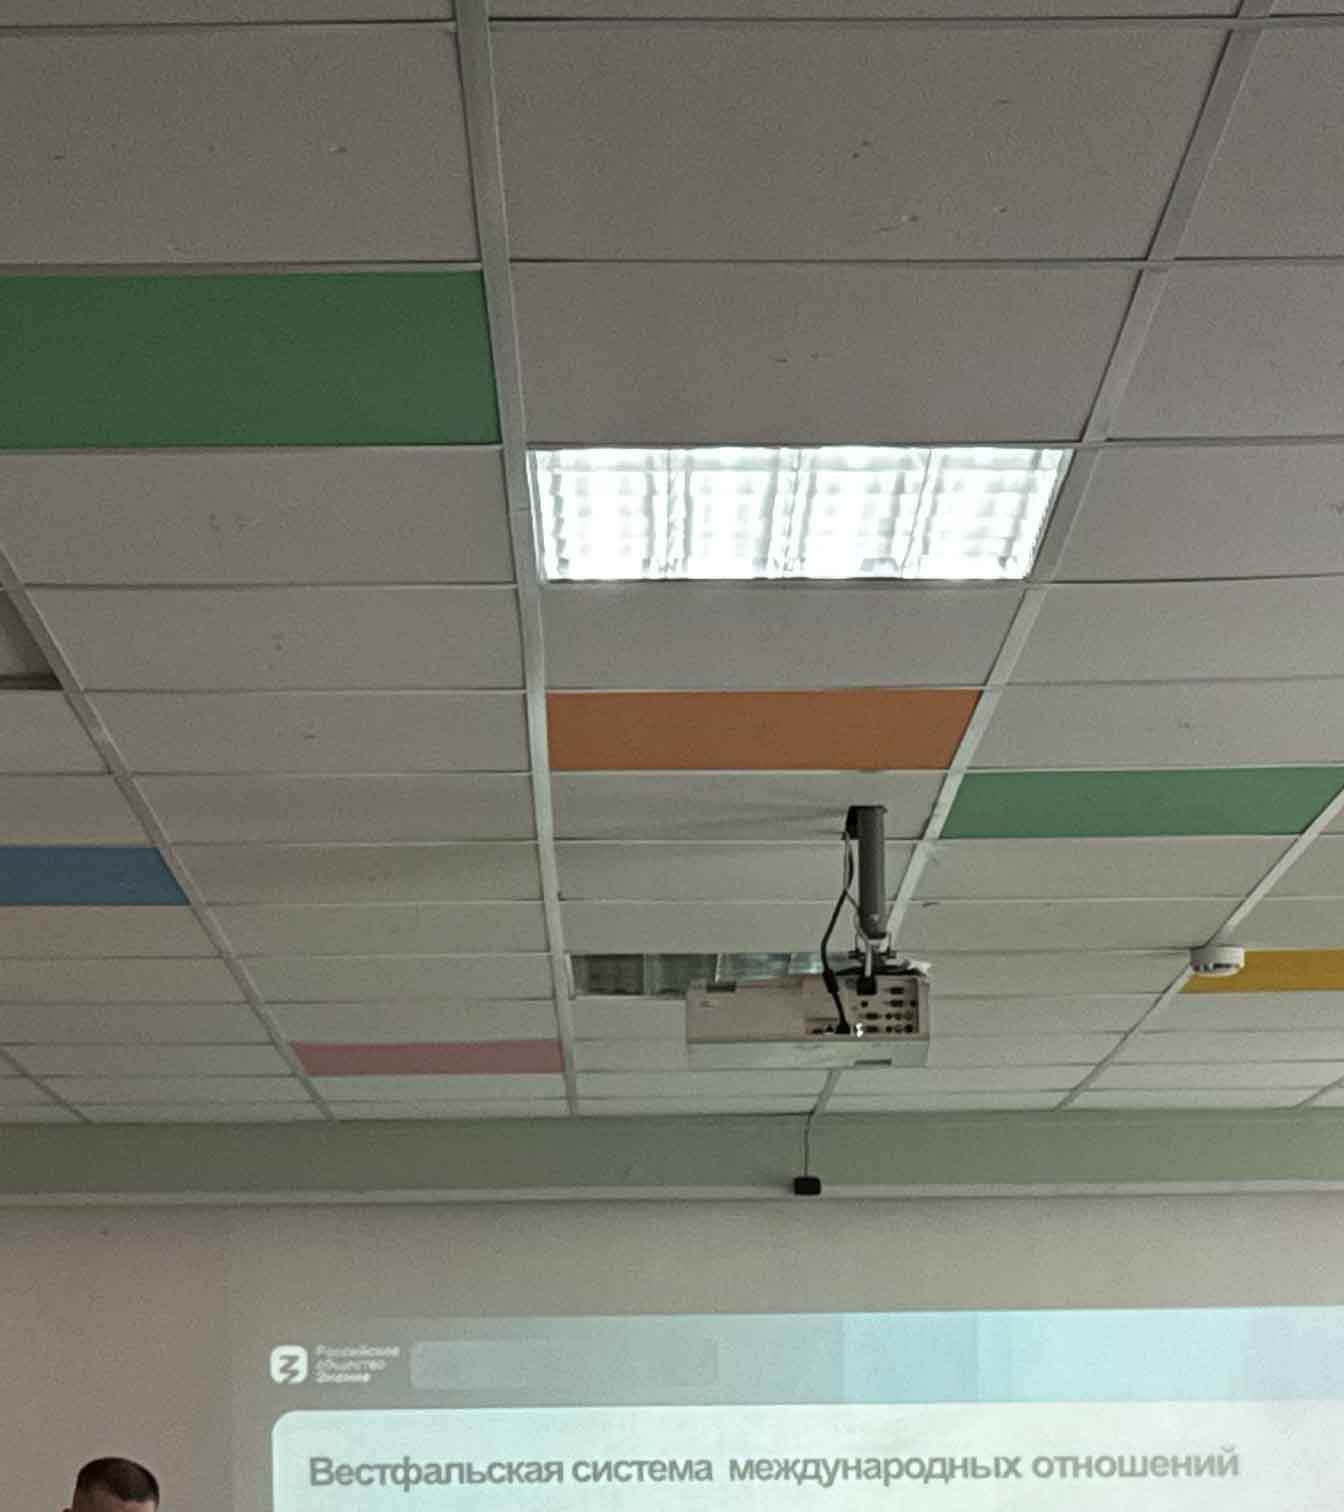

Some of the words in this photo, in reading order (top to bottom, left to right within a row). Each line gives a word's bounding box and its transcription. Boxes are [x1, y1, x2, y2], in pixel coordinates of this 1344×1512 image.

[309, 1456, 564, 1492] Вестфальская
[571, 1458, 713, 1483] система
[729, 1457, 1023, 1488] международных
[1031, 1444, 1239, 1479] отношений
